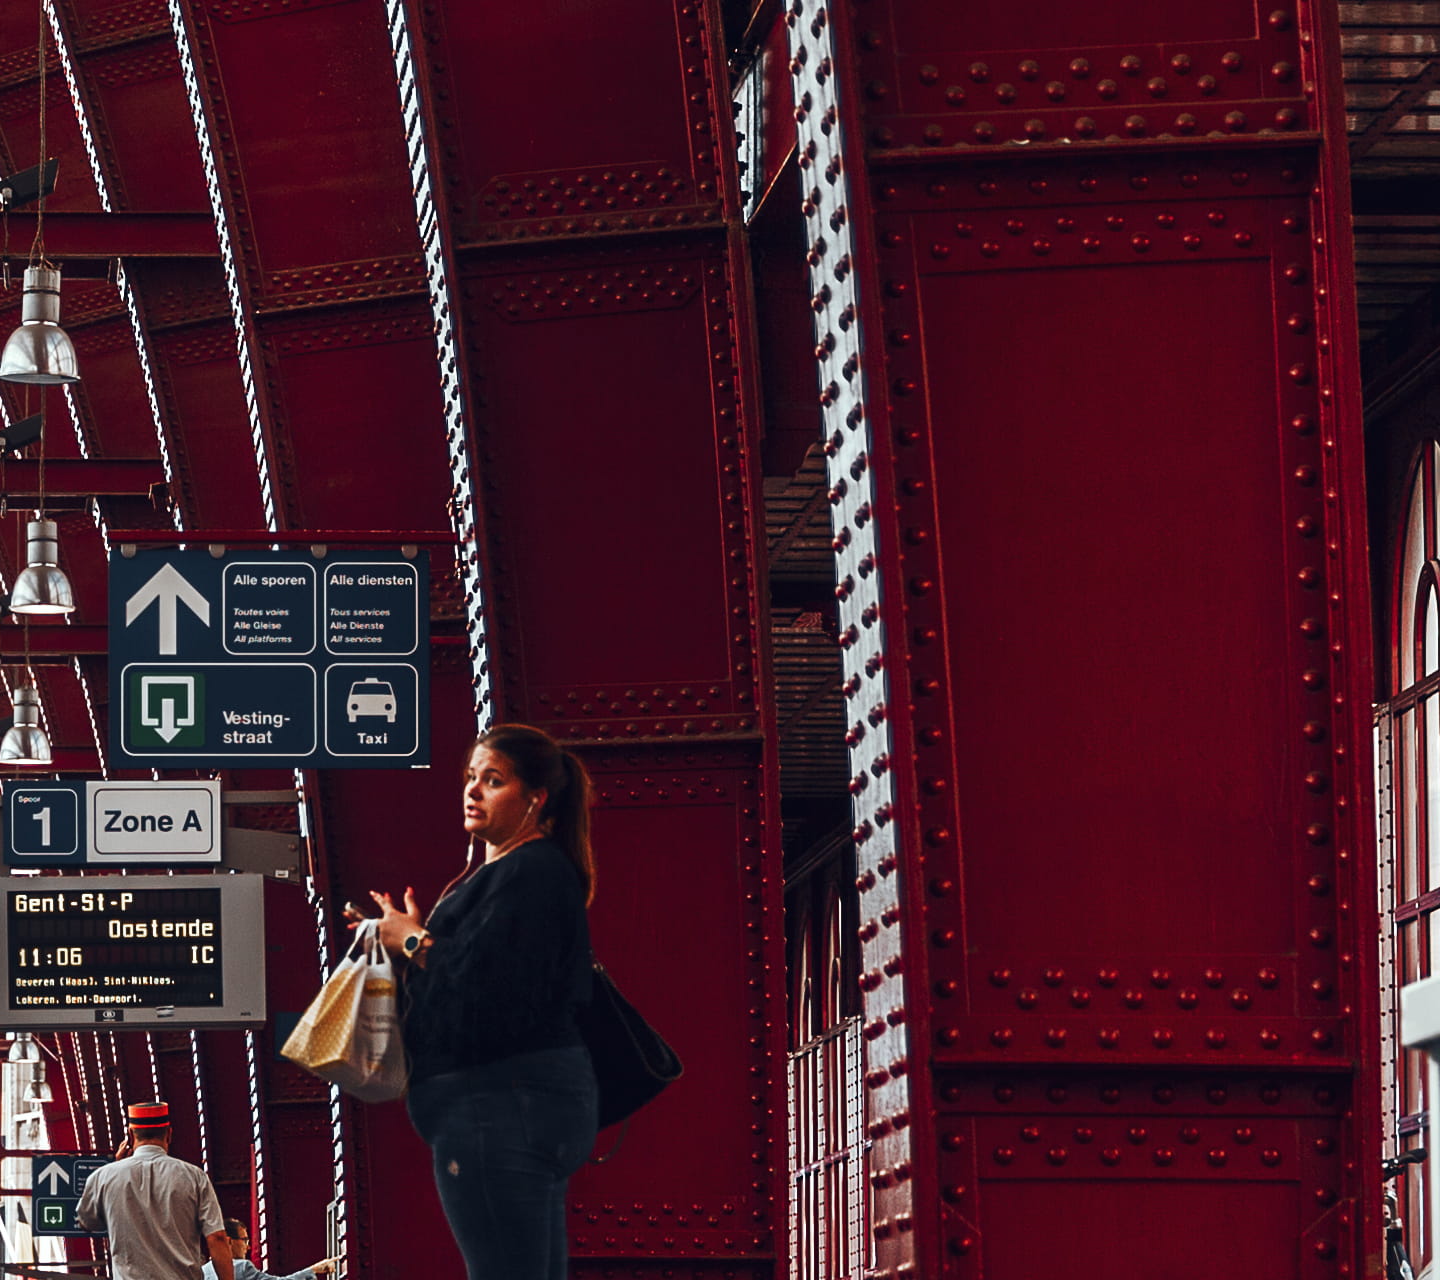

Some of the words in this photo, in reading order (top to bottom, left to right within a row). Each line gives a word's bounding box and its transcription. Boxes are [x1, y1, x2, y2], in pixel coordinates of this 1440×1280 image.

[233, 574, 258, 586] Alle
[261, 575, 306, 588] sporen
[329, 574, 354, 586] Alle
[357, 574, 413, 586] diensten
[233, 608, 263, 617] Toutes
[265, 608, 289, 617] voies
[329, 608, 351, 617] Tous
[353, 608, 391, 617] services
[233, 622, 251, 630] Alle
[253, 622, 282, 630] Gleise
[329, 622, 348, 630] Alle
[349, 622, 385, 630] Dienste
[233, 635, 247, 644] All
[248, 635, 293, 645] platforms
[330, 635, 343, 644] All
[344, 635, 383, 644] services
[222, 710, 291, 728] Vesting-
[222, 730, 273, 745] straat
[356, 732, 388, 745] Taxi
[32, 806, 51, 847] 1
[103, 809, 174, 833] Zone
[181, 809, 203, 833] A
[14, 892, 134, 913] Gent-St-P
[108, 918, 215, 939] Oostende
[18, 947, 83, 967] 11:06
[190, 945, 215, 964] IC
